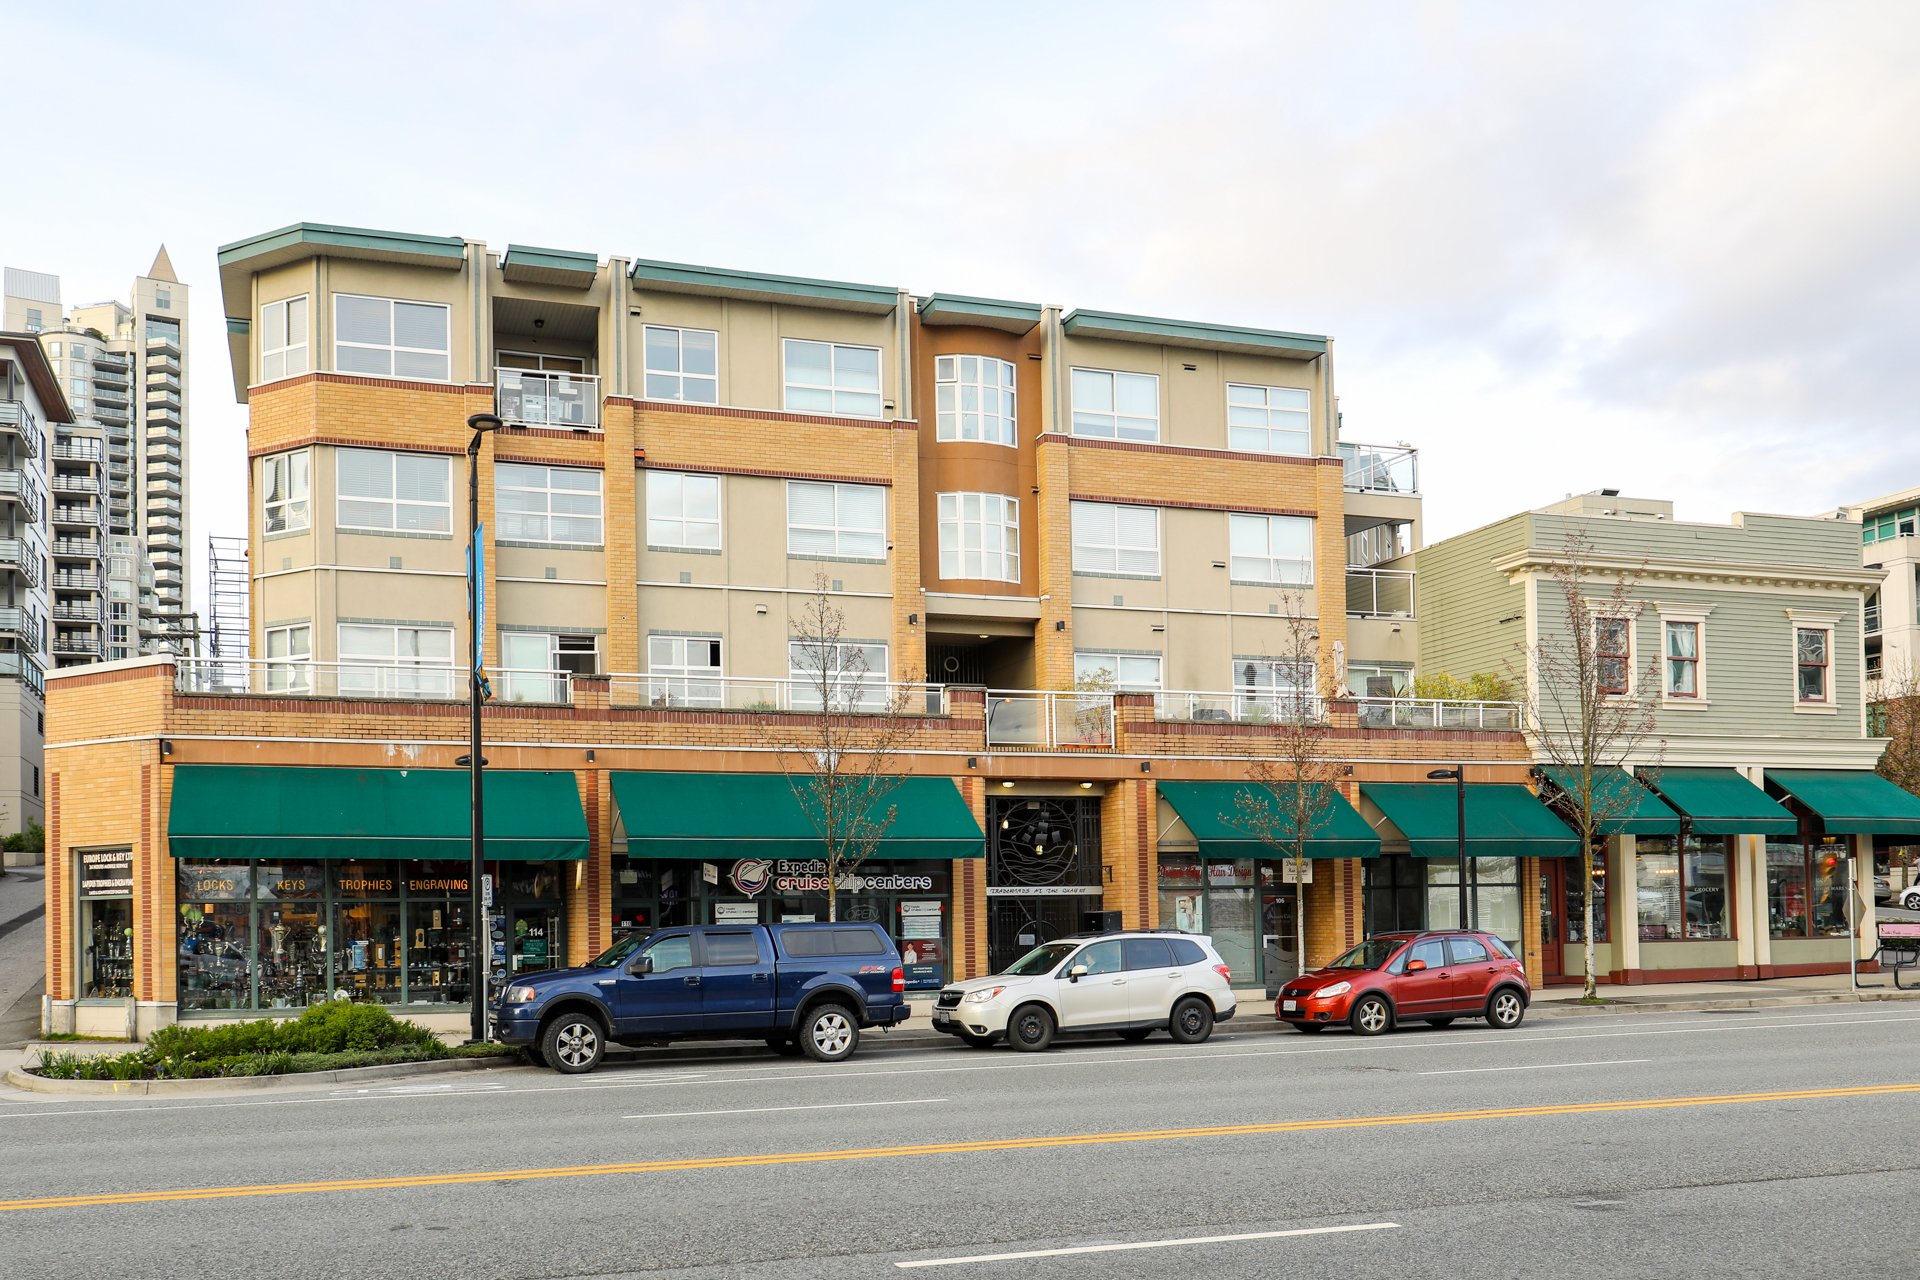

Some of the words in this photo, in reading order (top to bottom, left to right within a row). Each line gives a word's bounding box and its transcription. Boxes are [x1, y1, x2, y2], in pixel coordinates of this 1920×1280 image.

[84, 854, 100, 863] EUROPE
[101, 853, 112, 862] LOCK
[117, 852, 125, 861] KEY
[778, 859, 826, 875] Expedia
[1208, 864, 1226, 878] Hair
[1228, 864, 1252, 881] Design
[197, 879, 234, 891] LOCKS
[277, 879, 306, 891] KEYS
[338, 879, 393, 891] TROPHIES
[409, 879, 468, 891] ENGRAVING
[850, 907, 878, 919] OPEN
[528, 928, 544, 937] 114
